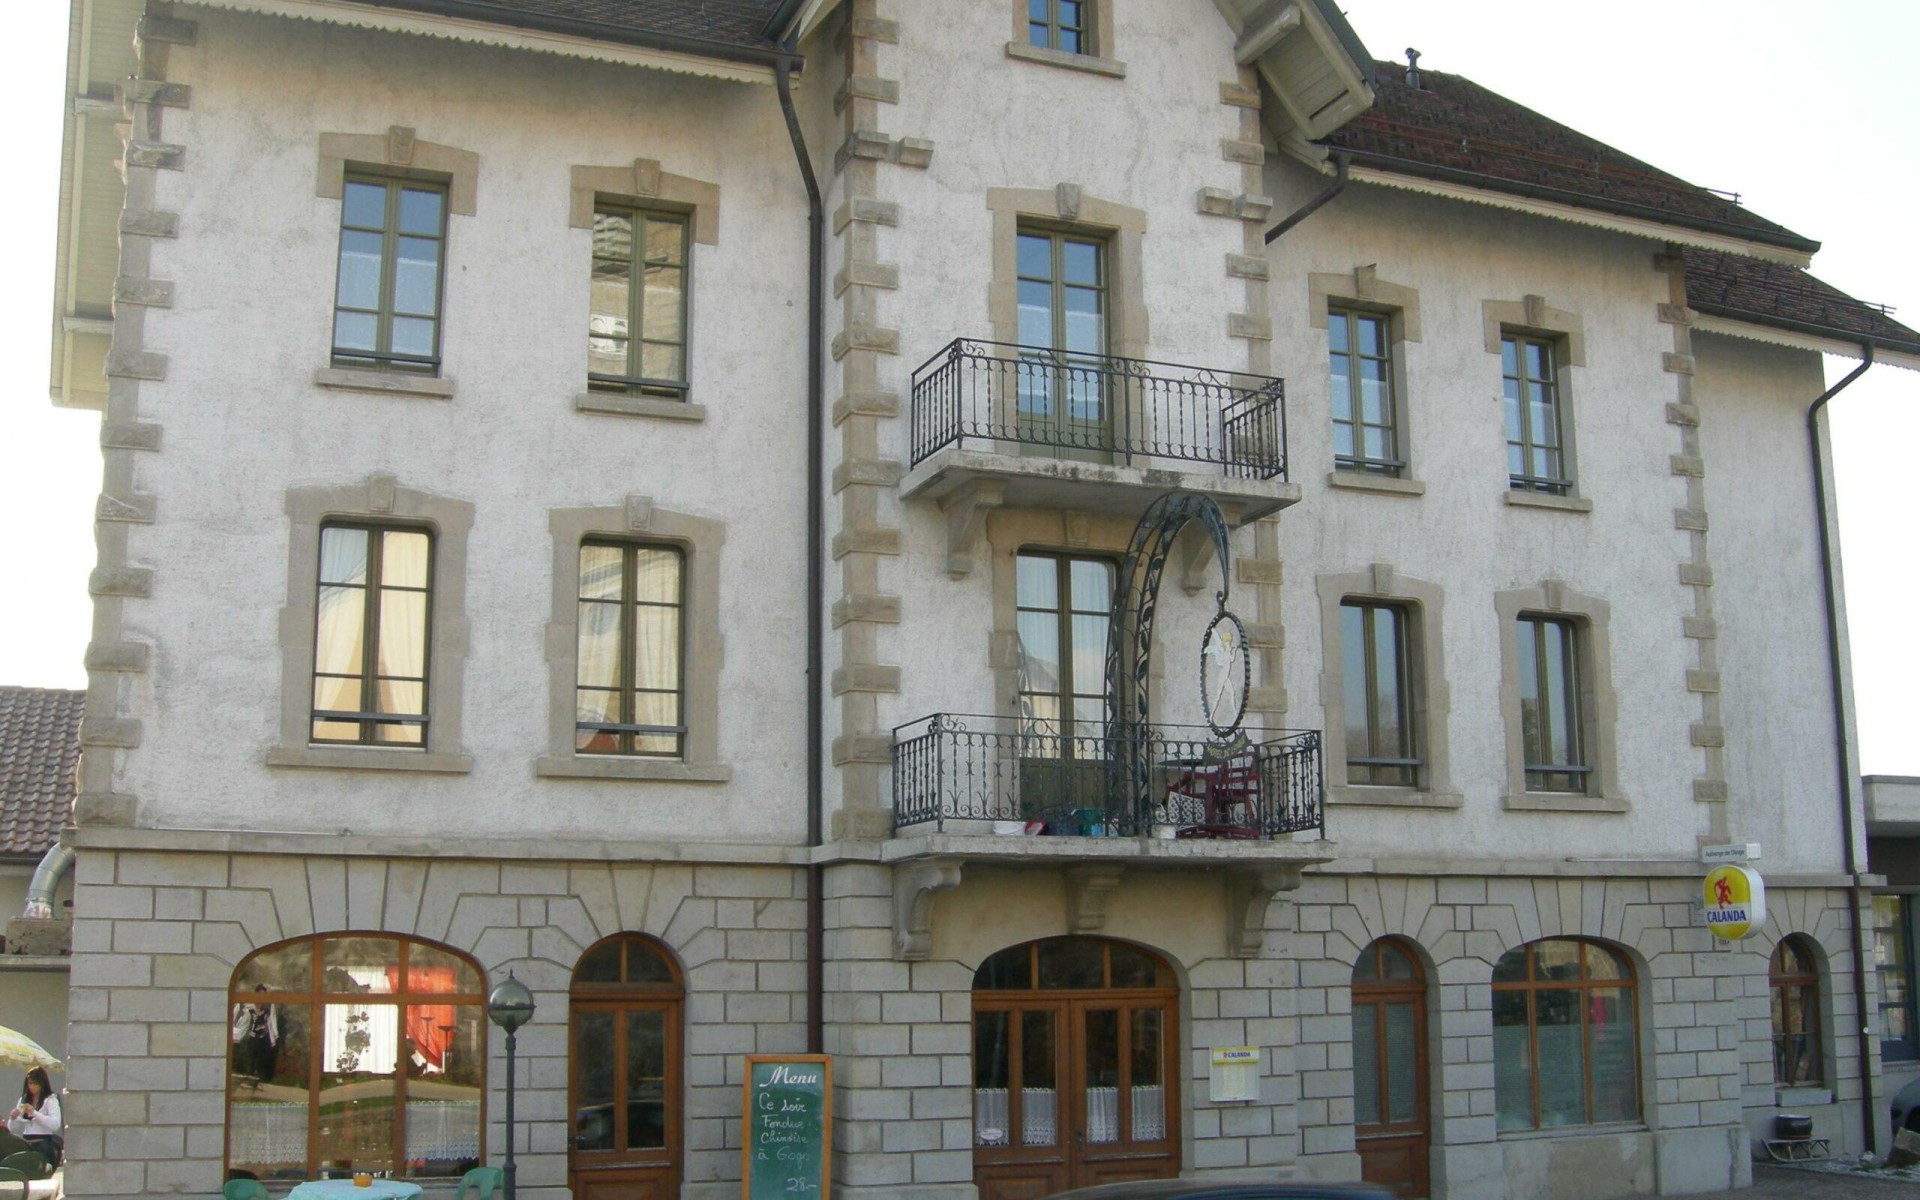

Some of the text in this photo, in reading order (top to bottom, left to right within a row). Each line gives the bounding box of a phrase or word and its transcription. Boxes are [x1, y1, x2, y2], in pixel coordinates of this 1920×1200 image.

[1707, 910, 1747, 923] CALANDA
[759, 1065, 817, 1087] Menu
[758, 1092, 774, 1110] Ce
[761, 1114, 805, 1128] Fondue
